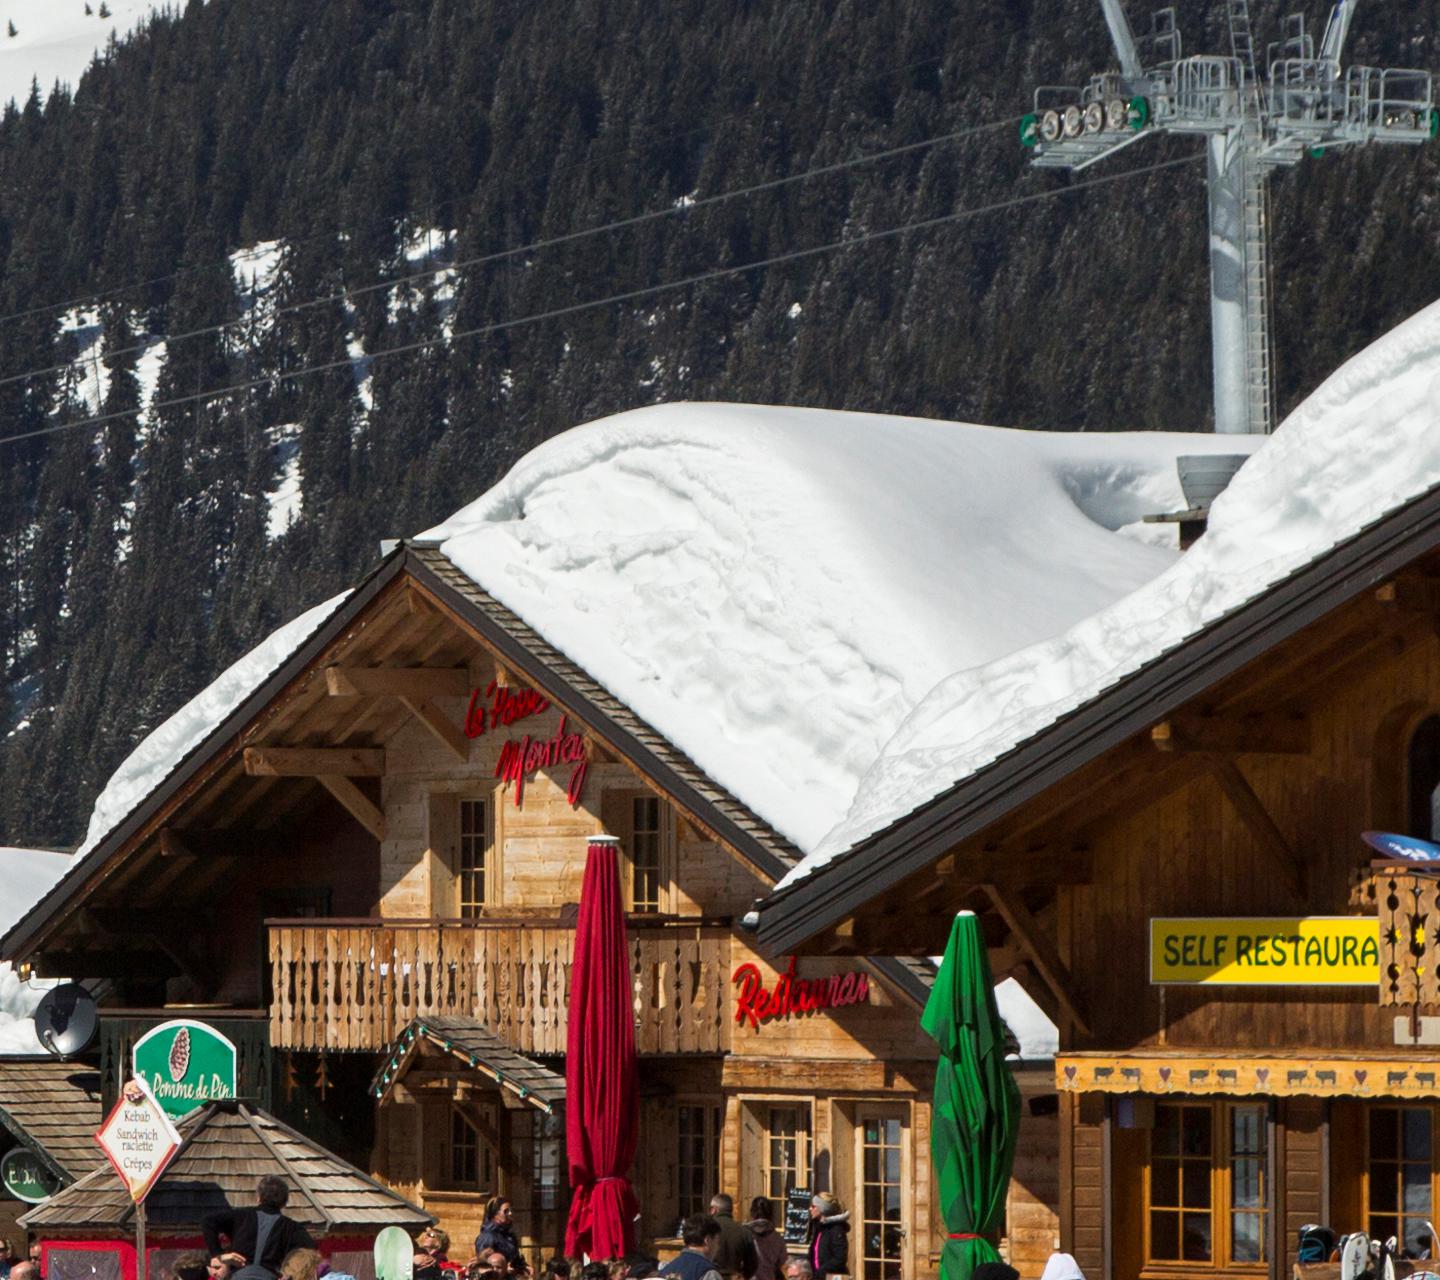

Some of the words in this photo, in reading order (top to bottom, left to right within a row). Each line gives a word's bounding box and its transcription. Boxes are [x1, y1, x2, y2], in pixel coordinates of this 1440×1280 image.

[1163, 934, 1229, 967] SELF
[153, 1072, 195, 1099] Pomme
[195, 1073, 210, 1099] de
[210, 1072, 232, 1099] Pin
[124, 1110, 150, 1122] Kebab
[116, 1127, 158, 1141] Sandwich
[122, 1140, 153, 1152] raclette
[123, 1157, 153, 1172] Crêpes
